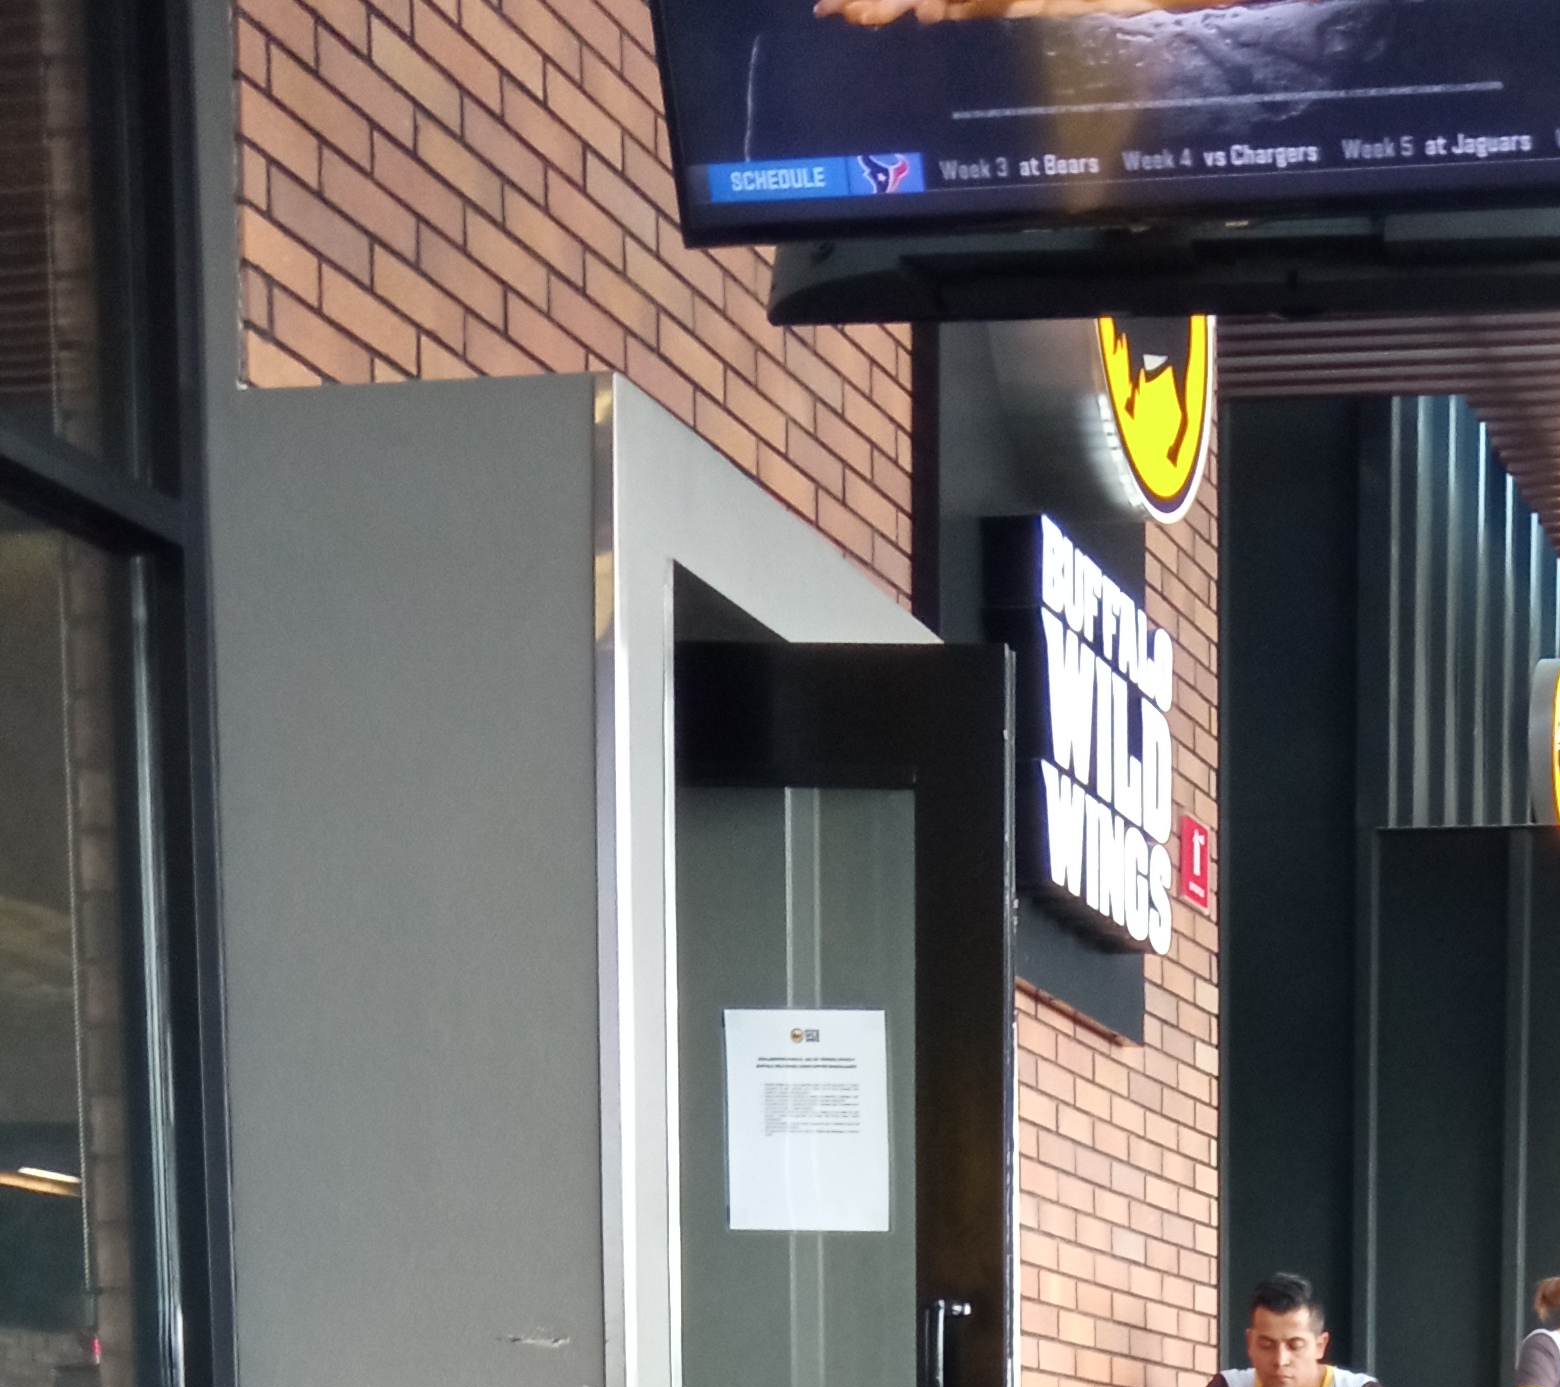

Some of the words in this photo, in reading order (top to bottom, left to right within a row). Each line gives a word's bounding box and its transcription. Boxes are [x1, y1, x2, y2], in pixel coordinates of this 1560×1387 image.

[731, 166, 826, 192] SCHEDULE
[939, 159, 991, 180] Week
[996, 156, 1008, 178] 3
[1019, 157, 1040, 177] at
[1043, 154, 1099, 175] Bears
[1122, 149, 1175, 171] Week
[1179, 148, 1192, 167] 4
[1203, 151, 1227, 167] vs
[1230, 144, 1319, 168] Chargers
[1342, 137, 1395, 159] Week
[1401, 135, 1413, 157] 5
[1425, 136, 1447, 156] at
[1451, 133, 1532, 158] Jaguars
[1041, 514, 1173, 713] BUFFALO
[1041, 606, 1173, 844] WILD
[1041, 759, 1173, 955] WINGS
